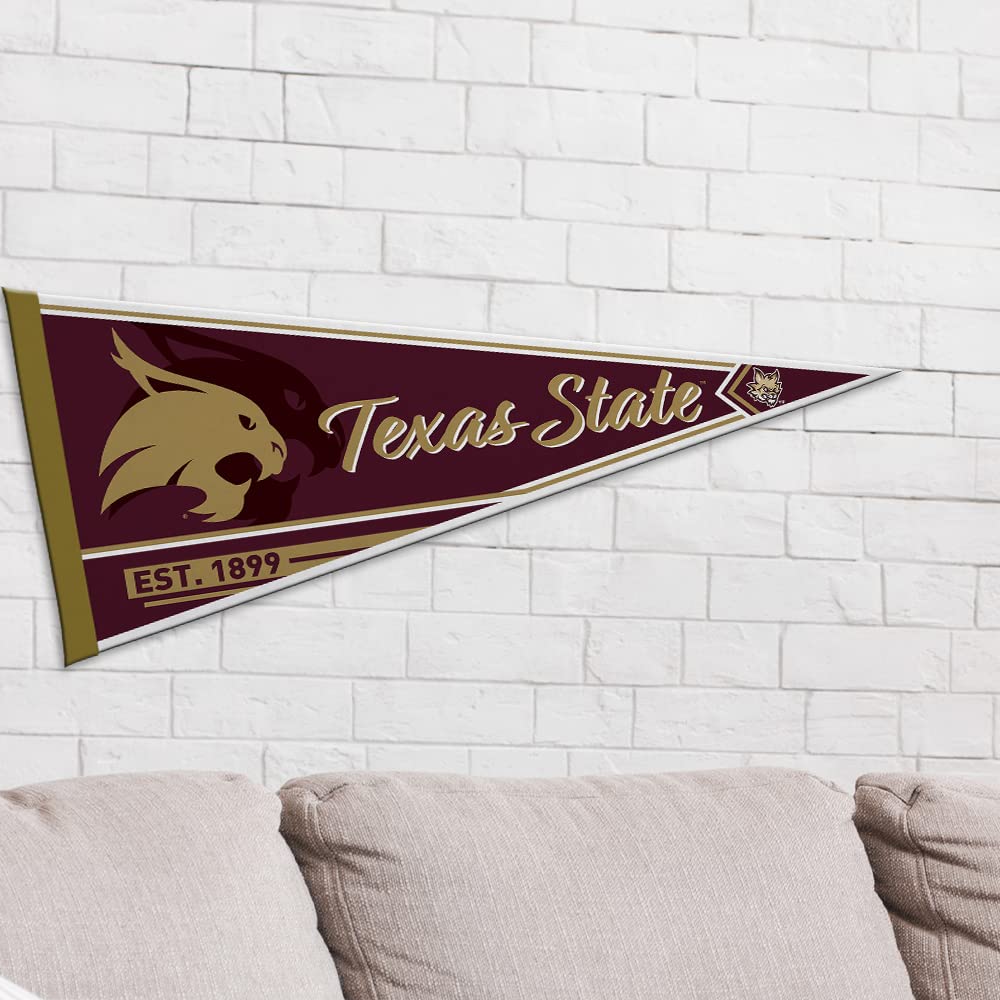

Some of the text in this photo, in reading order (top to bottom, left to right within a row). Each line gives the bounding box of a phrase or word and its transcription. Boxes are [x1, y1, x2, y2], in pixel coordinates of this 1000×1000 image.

[318, 369, 703, 473] Texas State
[134, 551, 280, 594] EST. 1899
